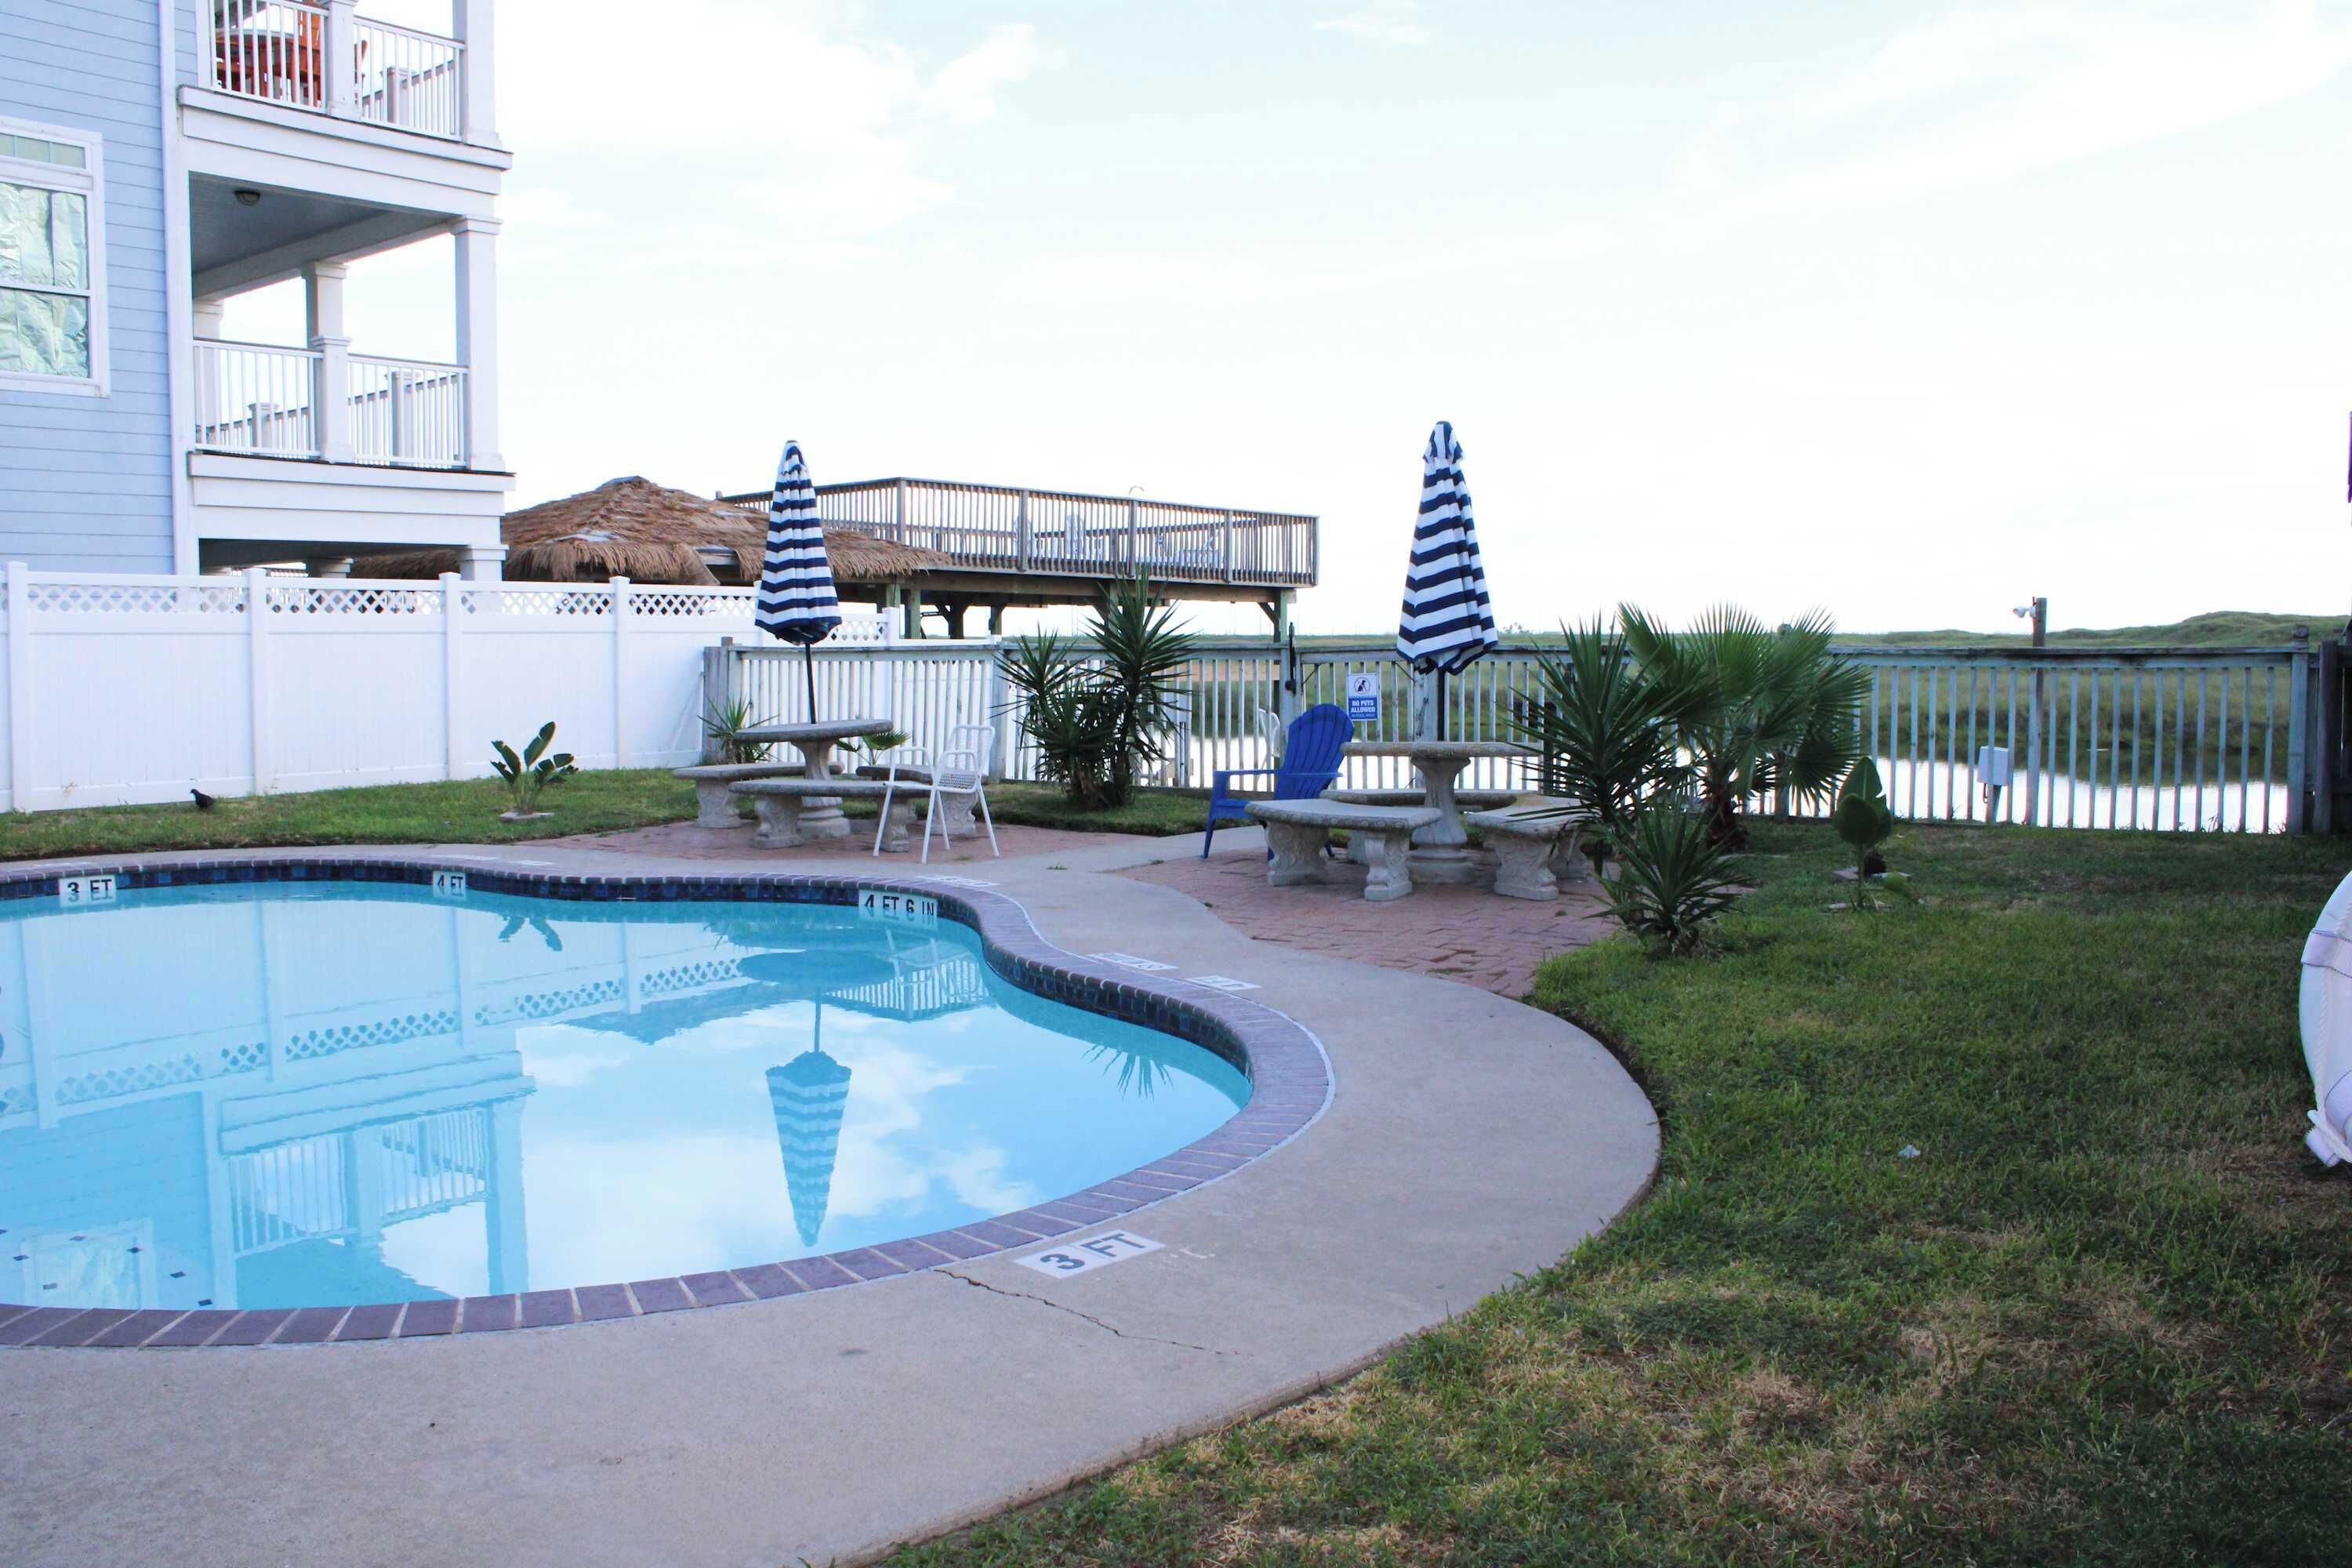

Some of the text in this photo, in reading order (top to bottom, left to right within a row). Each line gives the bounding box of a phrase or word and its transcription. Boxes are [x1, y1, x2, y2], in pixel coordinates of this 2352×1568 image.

[67, 879, 112, 894] 3 FT
[883, 895, 899, 910] FT
[906, 898, 915, 913] 6
[922, 901, 935, 916] IN
[1040, 1232, 1146, 1269] 3 FT
